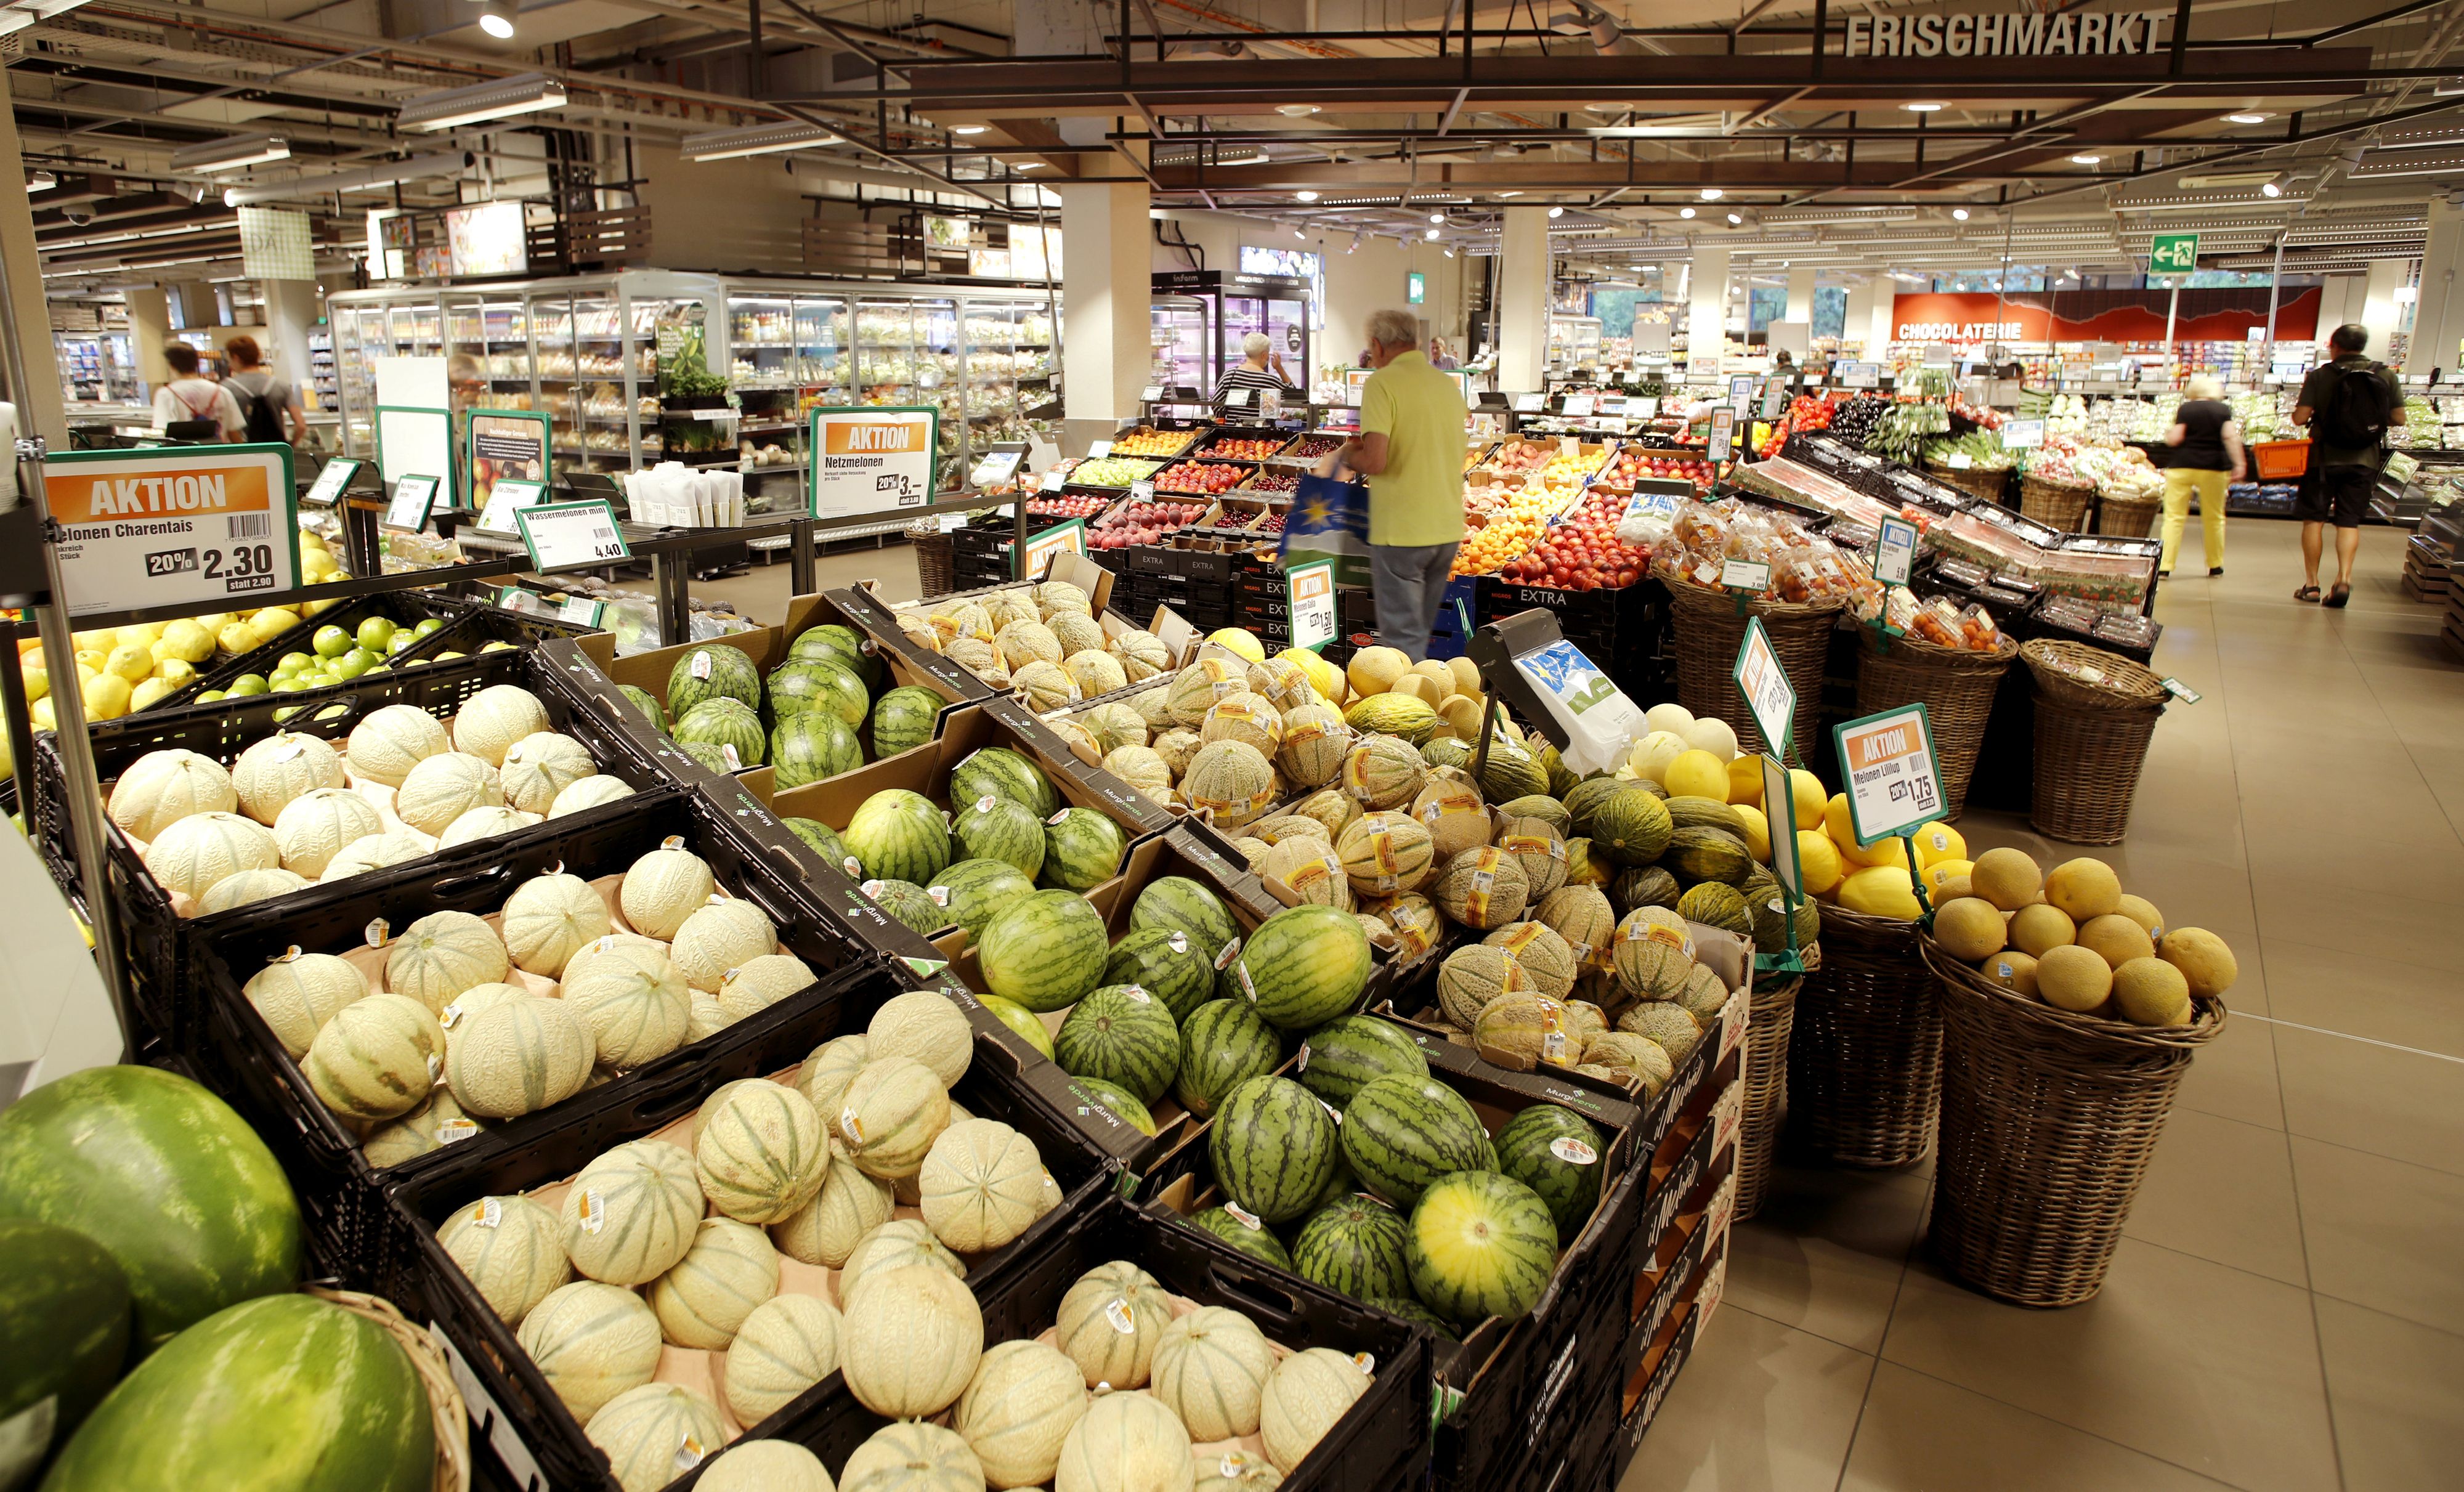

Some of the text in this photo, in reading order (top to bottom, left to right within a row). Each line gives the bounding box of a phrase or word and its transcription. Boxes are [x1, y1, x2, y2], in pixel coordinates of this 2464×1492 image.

[1846, 12, 2171, 57] FRISCHMARKT
[1899, 323, 2022, 340] CHOCOLATERIE
[848, 426, 909, 450] AKTION
[825, 456, 883, 469] Netzmelonen
[878, 476, 897, 490] 20%
[90, 474, 226, 516] AKTION
[526, 506, 606, 521] Wassermelonen mini
[60, 520, 193, 543] elonen Charentais
[1888, 527, 1908, 545] AKTUELL
[57, 545, 84, 553] nkreich
[60, 552, 81, 560] Stück
[595, 543, 622, 558] 4.40
[150, 544, 273, 579] 20% 2.30
[1143, 556, 1163, 566] EXTRA
[1193, 561, 1214, 570] EXTRA
[230, 576, 272, 590] statt 2.90
[1896, 567, 1907, 580] 5.90
[1267, 582, 1286, 594] EXT
[1300, 575, 1322, 598] AKTION
[1521, 589, 1566, 606] EXTRA
[841, 601, 872, 625] Murgiverde
[1269, 604, 1288, 615] EXT
[1294, 602, 1307, 613] Melonen
[1269, 623, 1289, 635] EXT
[1319, 611, 1332, 628] 1.50
[572, 653, 603, 683] Murgiverde
[929, 665, 963, 690] Murgiverde
[1746, 645, 1763, 692] AKTION
[1595, 683, 1611, 694] MIGROS
[1774, 675, 1786, 705] 2.80
[1001, 712, 1036, 739] Murgiverde
[658, 737, 694, 767] Murgiverde
[1862, 728, 1907, 763] AKTION
[1854, 769, 1881, 786] Melonen
[1891, 775, 1932, 801] 20% 1.75
[736, 792, 774, 827] Murgiverde
[1104, 788, 1143, 817] Murgiverde
[1187, 845, 1228, 875] Murgiverde
[845, 890, 888, 926] Murgiverde
[1068, 1084, 1120, 1128] Murgiverde
[1546, 1087, 1602, 1112] Murgiverde
[1660, 1057, 1706, 1140] Melone
[1655, 1159, 1700, 1246] Melone
